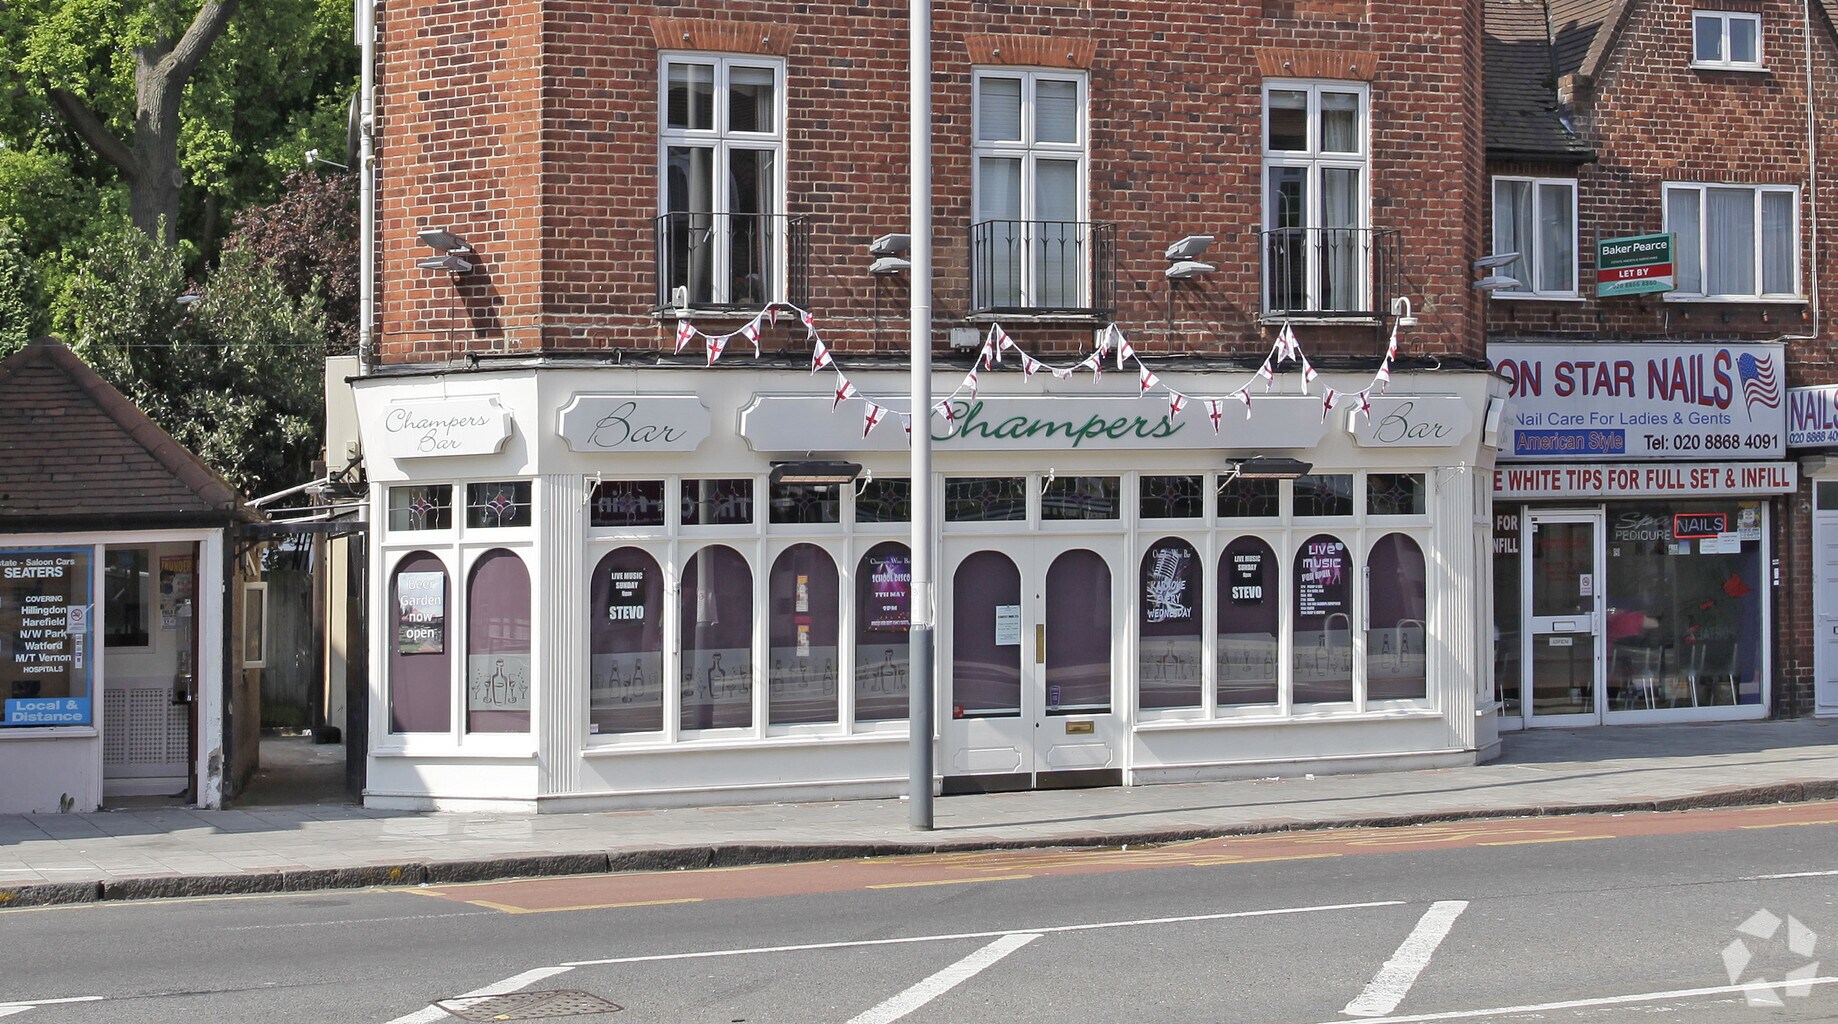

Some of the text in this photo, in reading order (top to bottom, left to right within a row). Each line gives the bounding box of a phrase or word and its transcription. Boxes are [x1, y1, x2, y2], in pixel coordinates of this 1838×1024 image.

[1602, 241, 1667, 255] Baker Pearce
[1619, 268, 1649, 278] LET BY
[1487, 349, 1733, 410] ON STAR NAILS
[385, 408, 490, 436] Champers
[587, 401, 687, 448] Bar
[931, 400, 1186, 448] Champers
[1372, 401, 1453, 443] Bar
[1515, 411, 1731, 426] Nail Care For Ladies & Gents
[417, 429, 463, 453] Bar
[1516, 430, 1624, 454] American Style
[1644, 434, 1778, 450] Tel: 020 8868 4091
[1789, 432, 1804, 444] 020
[1806, 431, 1826, 442] 8868
[1508, 470, 1561, 491] WHITE
[1566, 469, 1602, 490] TIPS
[1608, 469, 1640, 490] FOR
[1646, 469, 1685, 489] FULL
[1690, 468, 1719, 488] SET
[1725, 468, 1736, 488] &
[1741, 467, 1790, 487] INFILL
[1497, 515, 1518, 530] FOR
[1676, 518, 1724, 533] NAILS
[26, 558, 53, 566] Saloon
[56, 557, 75, 566] Cars
[4, 566, 63, 579] SEATERS
[611, 572, 643, 580] LIVE MUSIC
[872, 573, 911, 583] SCHOOL DISCO
[408, 578, 435, 590] Beer
[615, 581, 638, 589] SUNDAY
[1232, 585, 1262, 599] STEVO
[25, 595, 63, 603] COVERING
[400, 595, 442, 607] Garden
[21, 605, 67, 616] Hillingdon
[609, 605, 644, 620] STEVO
[1147, 606, 1192, 619] WEDNESDAY
[22, 617, 66, 627] Harefield
[409, 613, 433, 622] now
[20, 629, 67, 638] N/W Park
[406, 629, 435, 641] open
[25, 641, 63, 651] Watford
[15, 653, 72, 663] M/T Vernon
[23, 665, 64, 673] HOSPITALS
[16, 699, 79, 711] Local &
[12, 711, 83, 722] Distance
